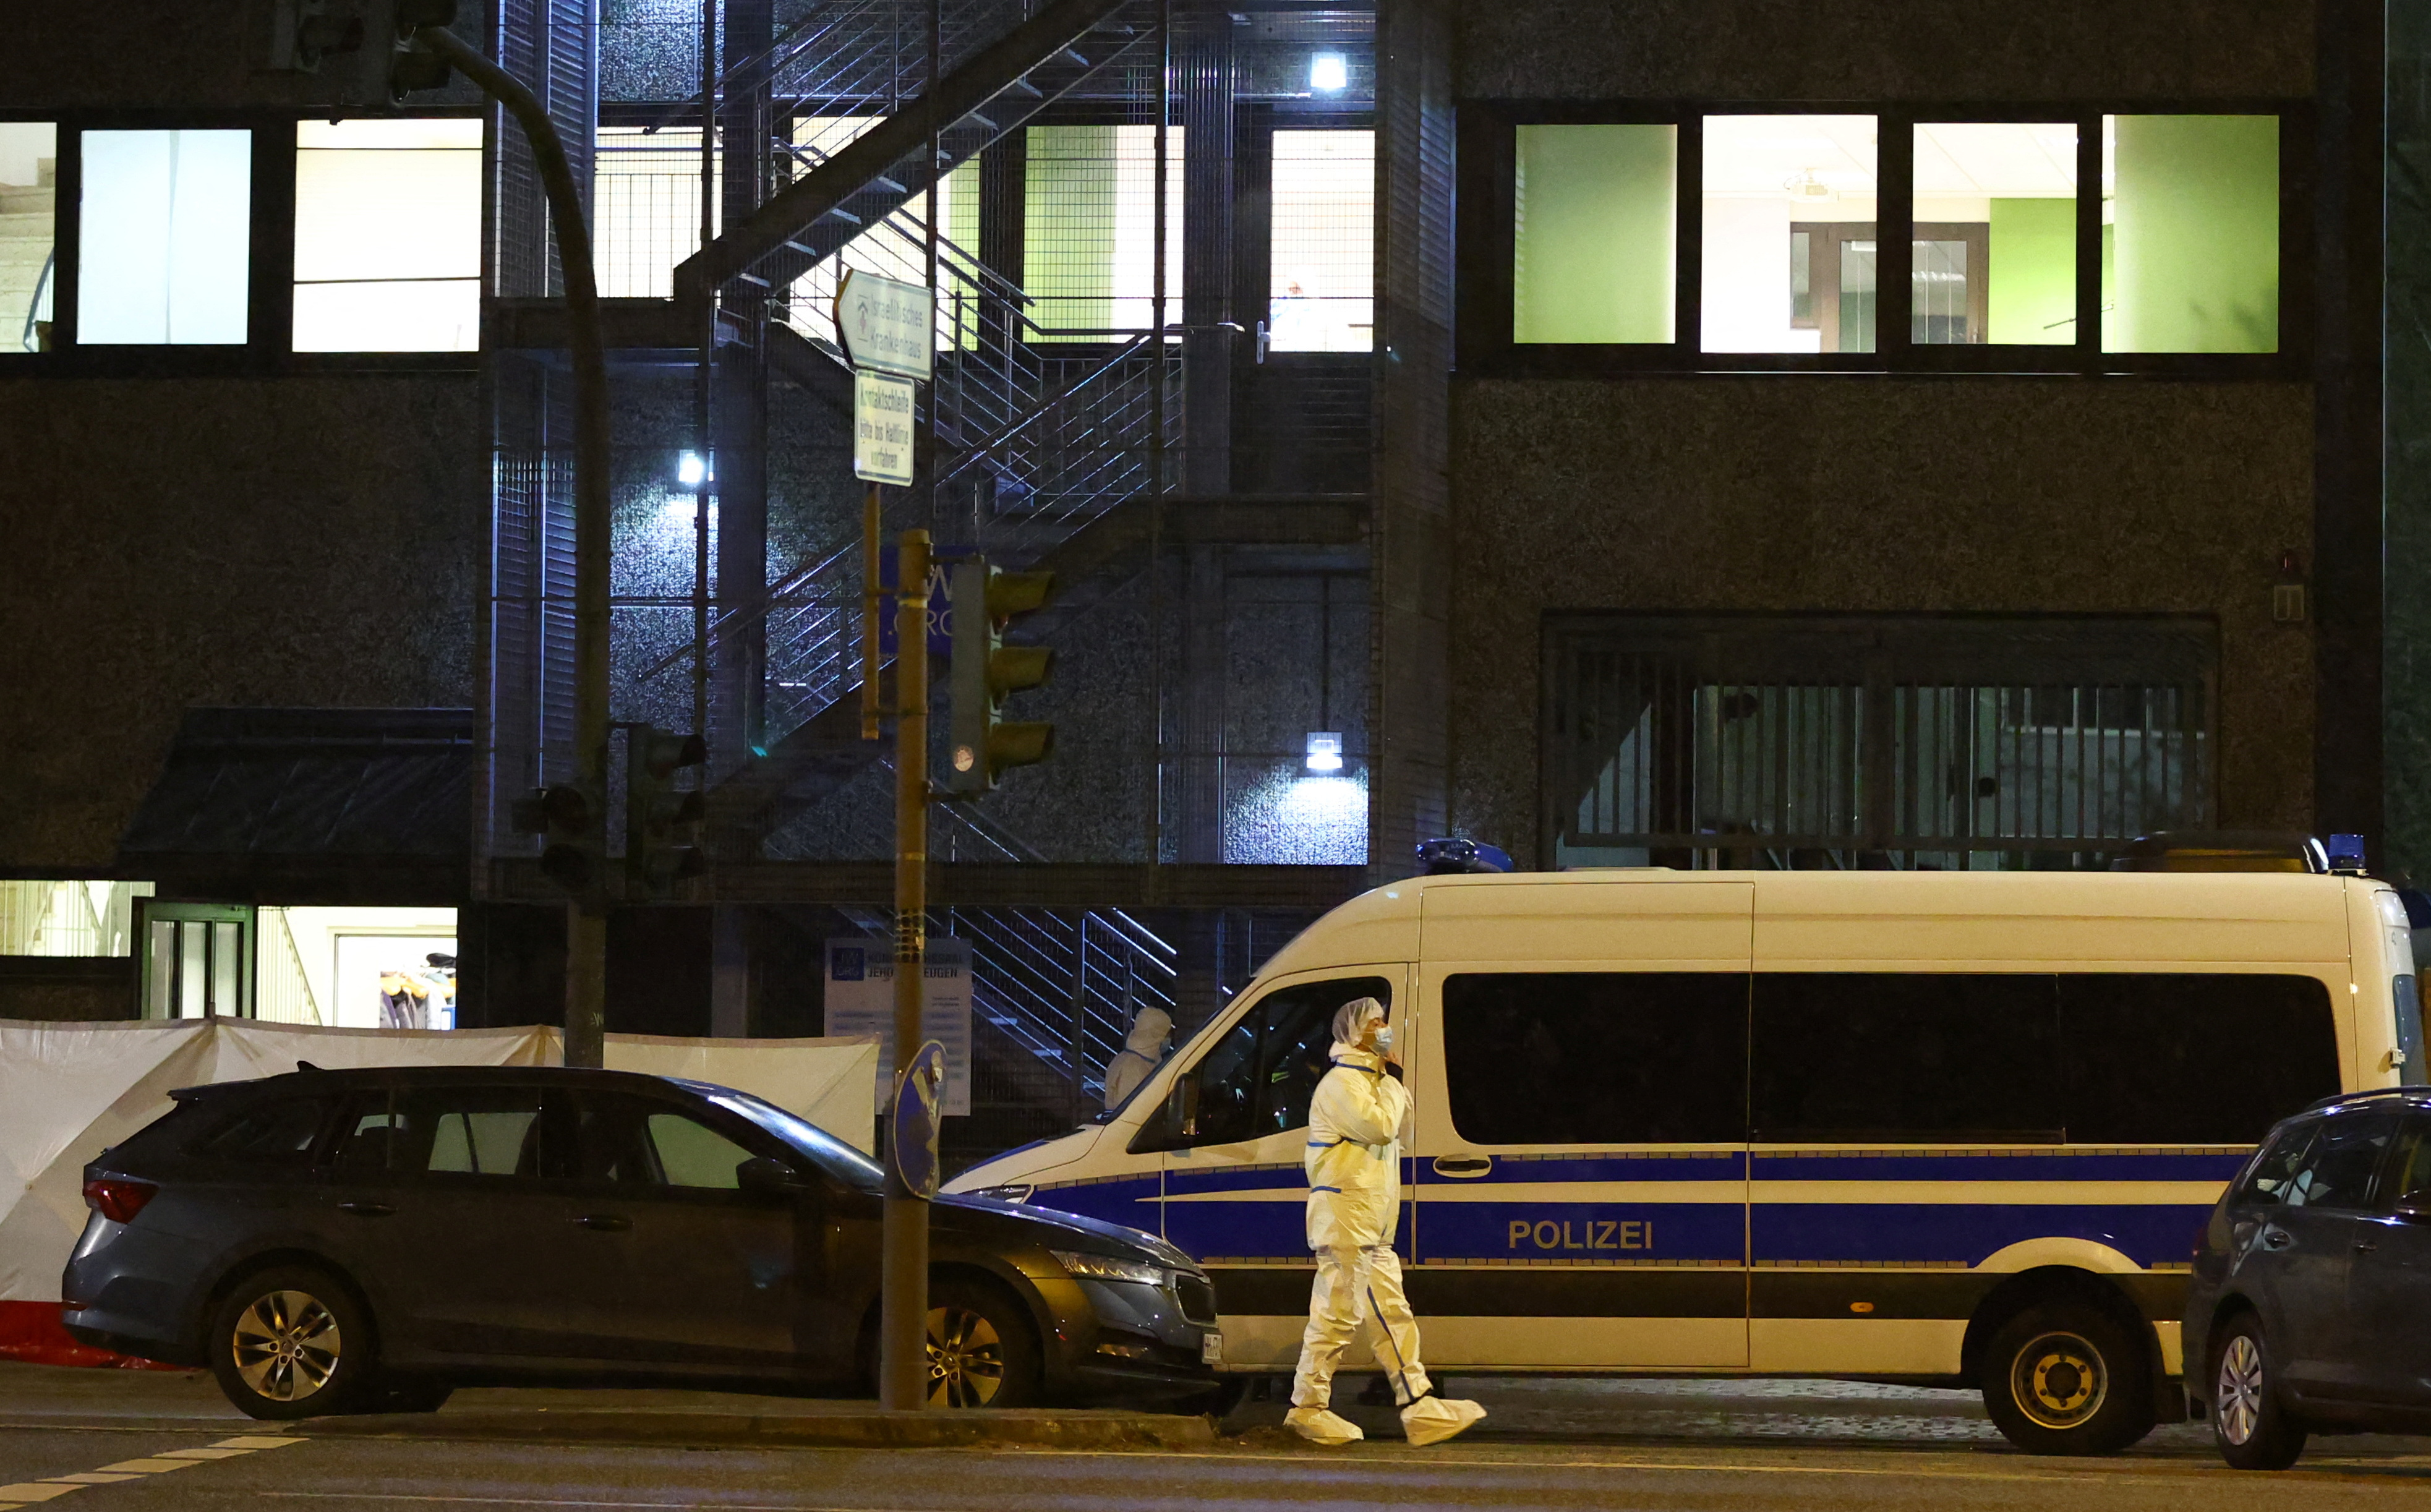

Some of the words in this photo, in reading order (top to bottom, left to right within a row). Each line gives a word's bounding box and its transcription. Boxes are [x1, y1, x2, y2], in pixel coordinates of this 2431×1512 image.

[869, 325, 921, 359] Krankenhaus
[868, 967, 894, 978] JEHO
[924, 967, 958, 978] EUGEN
[1509, 1221, 1652, 1249] POLIZEI
